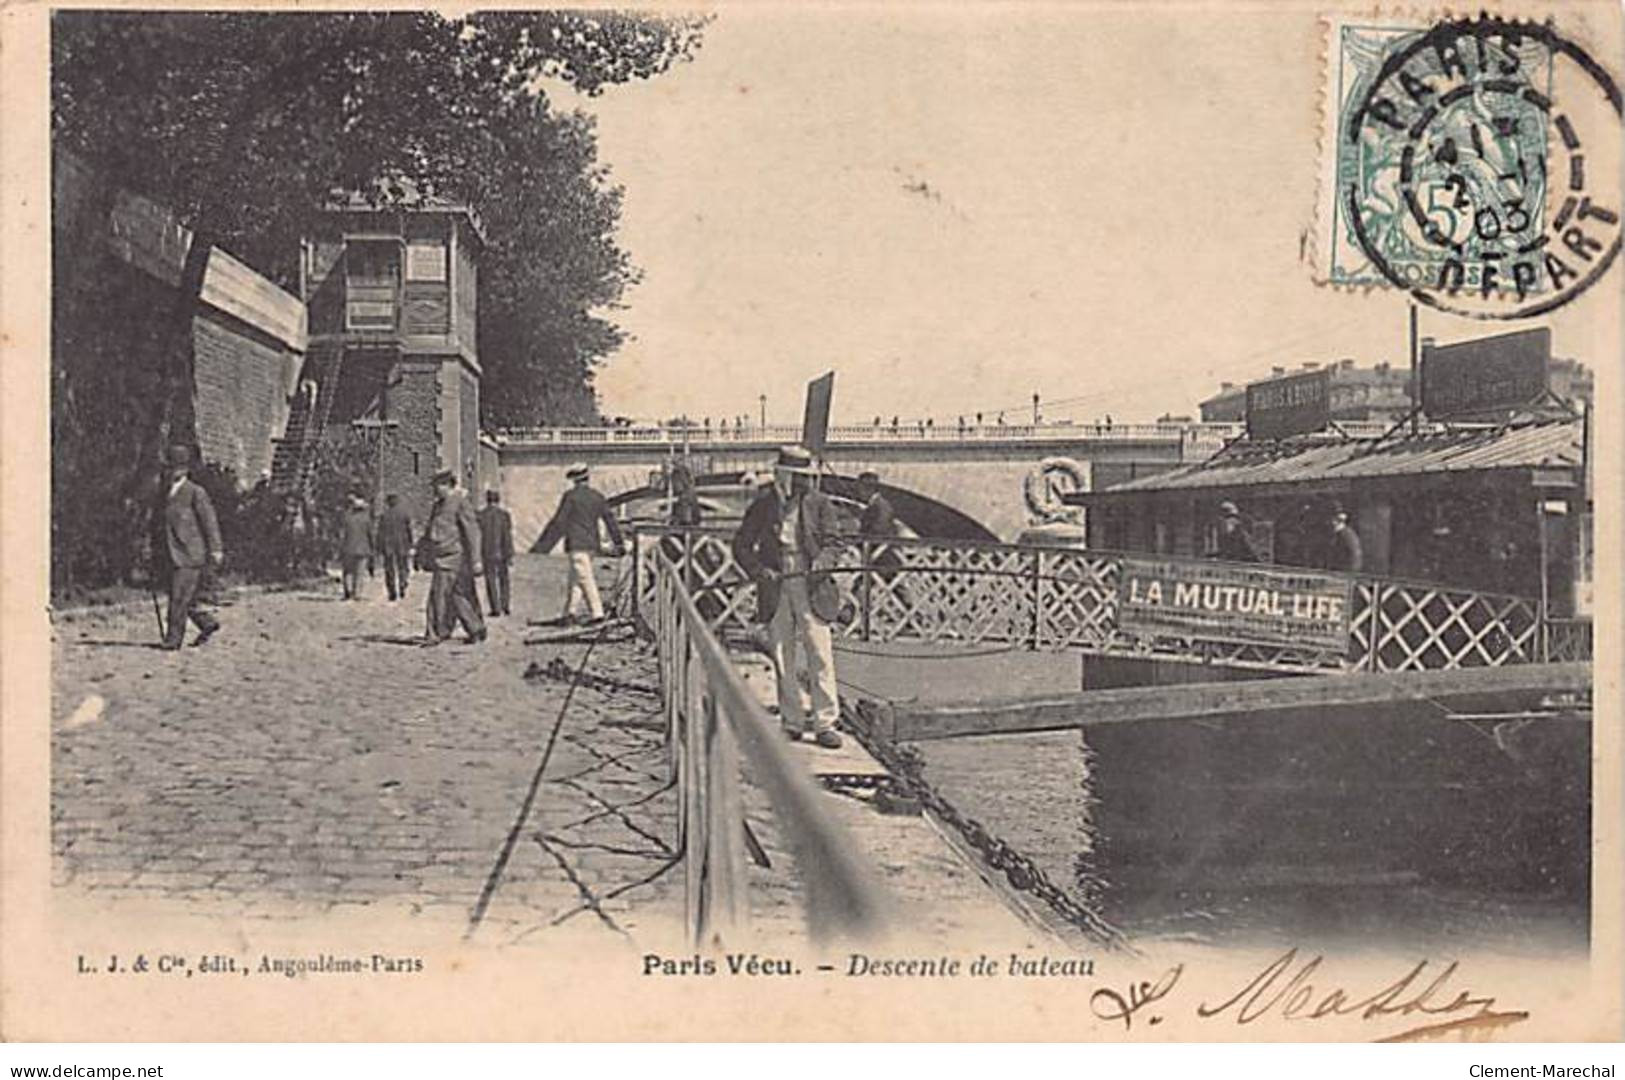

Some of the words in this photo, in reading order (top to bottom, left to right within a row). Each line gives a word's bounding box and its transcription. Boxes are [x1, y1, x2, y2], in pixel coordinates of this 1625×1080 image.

[1366, 26, 1522, 130] PARIS
[1129, 578, 1162, 606] LA
[1173, 581, 1285, 616] MUTUAL
[1292, 592, 1343, 622] LIFE
